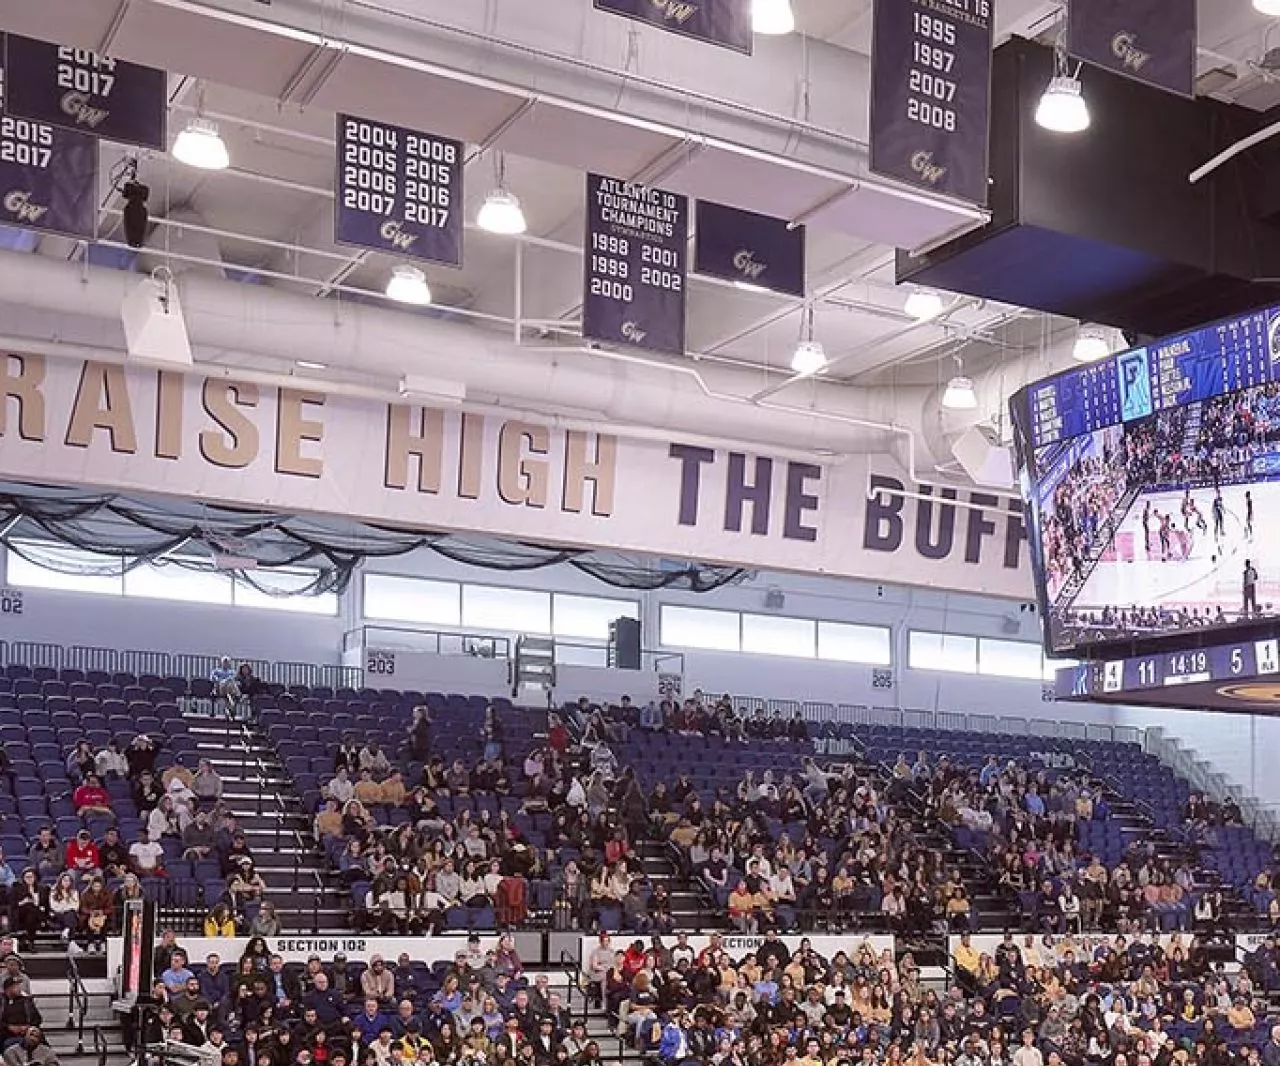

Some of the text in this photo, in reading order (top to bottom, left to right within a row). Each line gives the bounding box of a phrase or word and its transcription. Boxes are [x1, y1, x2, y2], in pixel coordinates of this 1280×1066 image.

[914, 13, 956, 46] 1995
[914, 41, 954, 72] 1997
[57, 64, 115, 96] 2017
[909, 69, 956, 101] 2007
[908, 98, 956, 131] 2008
[1, 118, 52, 145] 2015
[345, 121, 455, 163] 2004 2008
[1, 141, 51, 168] 2017
[345, 144, 449, 185] 2005 2015
[345, 167, 449, 206] 2006 2016
[344, 188, 449, 228] 2007 2017
[597, 191, 679, 224] TOURNAMENT
[601, 208, 674, 237] CHAMPIONS
[592, 232, 678, 268] 1998 2001
[590, 278, 633, 301] 2000
[592, 255, 682, 292] 1999 2002
[0, 351, 327, 478] RAISE
[383, 400, 617, 517] HIGH
[668, 442, 819, 543] THE
[368, 658, 395, 675] 203
[1139, 660, 1155, 684] 11
[1170, 652, 1206, 674] 14:19
[1231, 649, 1243, 674] 5
[278, 940, 367, 951] SECTION 102
[722, 938, 764, 948] ECTION
